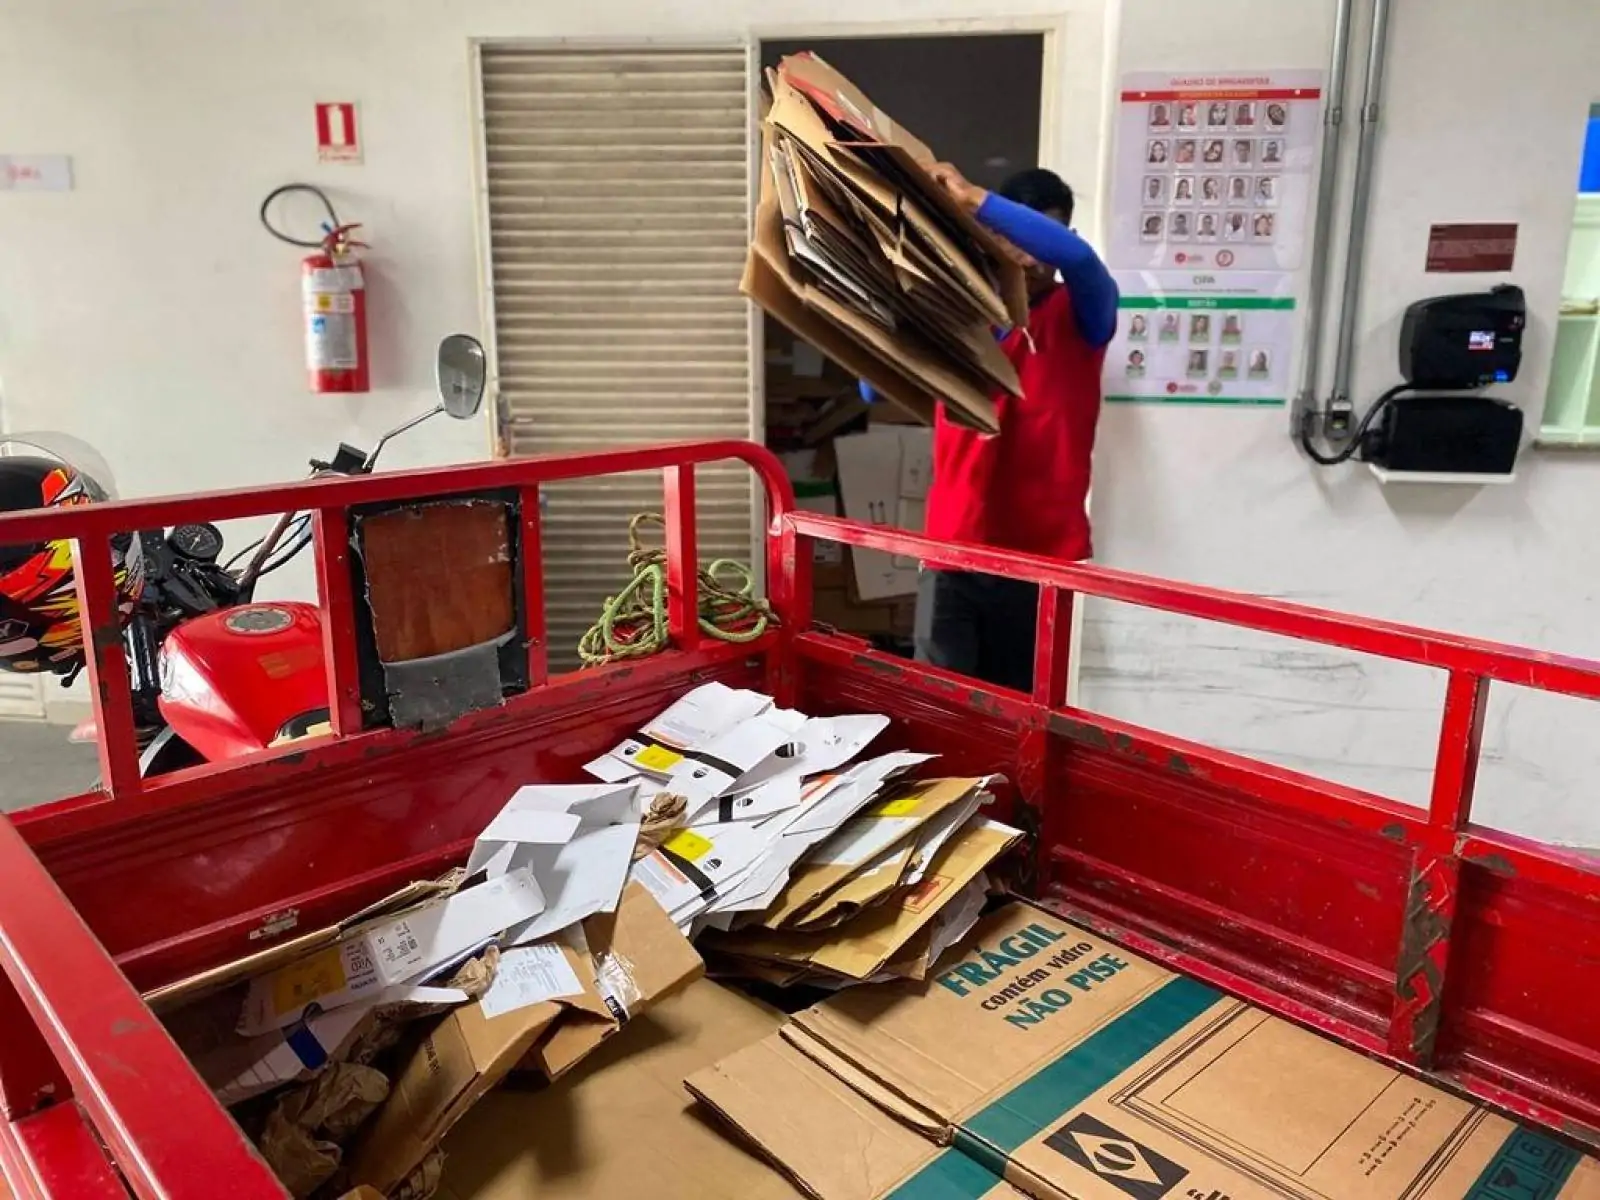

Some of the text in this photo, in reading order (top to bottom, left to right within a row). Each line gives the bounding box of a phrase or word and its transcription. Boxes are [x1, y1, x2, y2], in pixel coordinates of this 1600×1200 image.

[1192, 275, 1216, 285] CIPA
[936, 922, 1067, 998] FRÁGIL
[980, 941, 1094, 1011] contém vidro
[1003, 952, 1129, 1031] NÃO PISE
